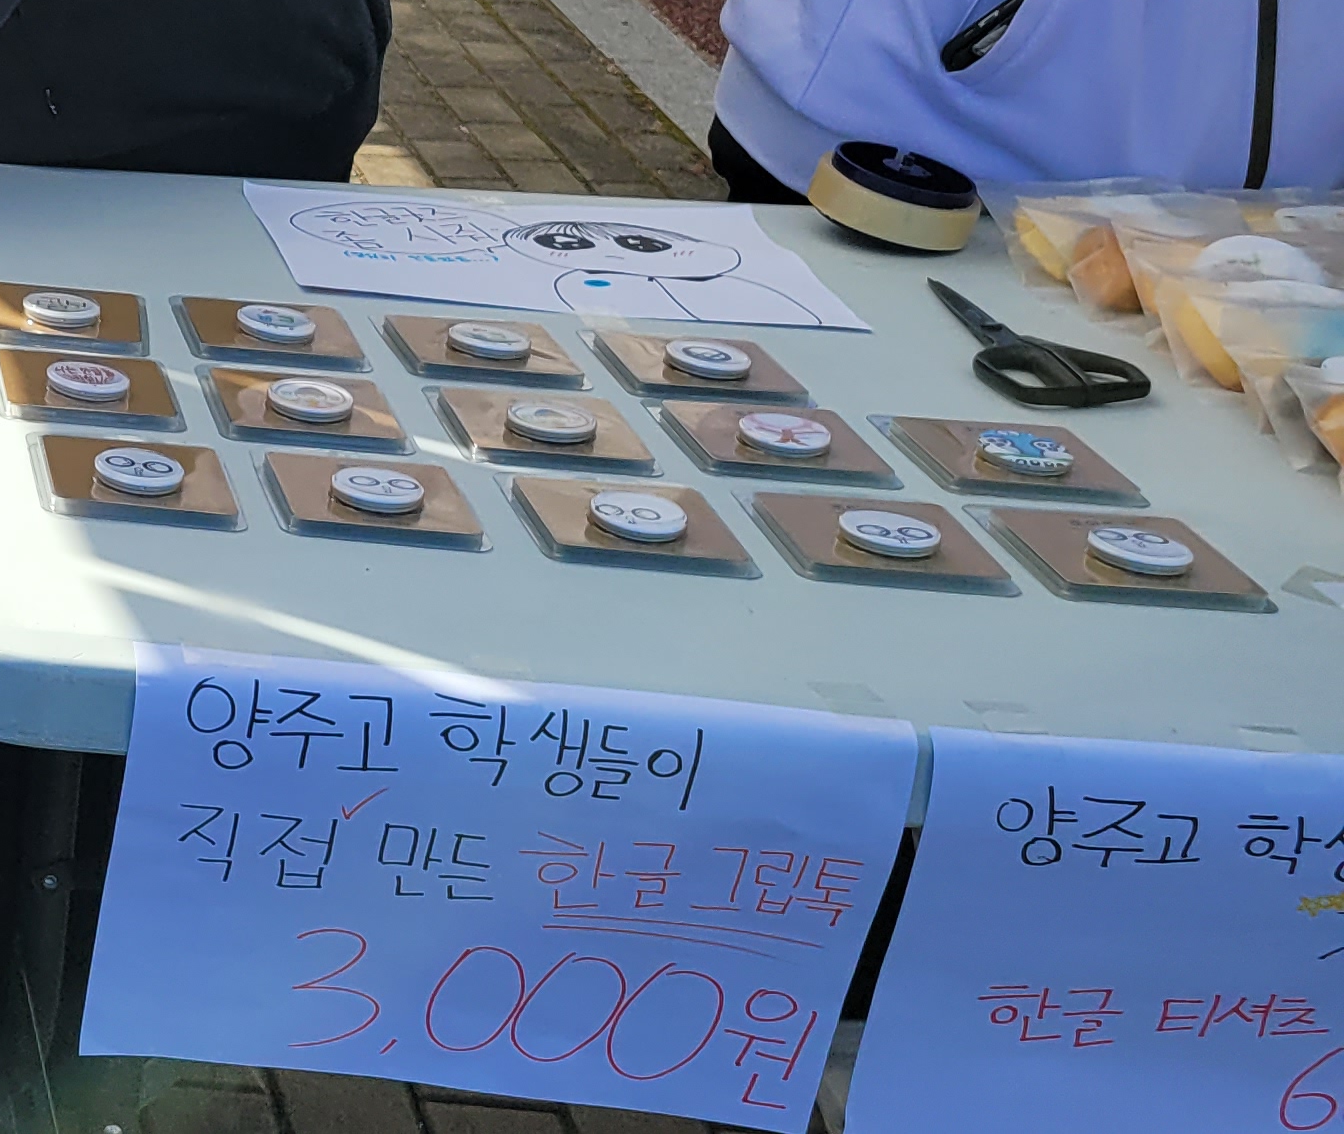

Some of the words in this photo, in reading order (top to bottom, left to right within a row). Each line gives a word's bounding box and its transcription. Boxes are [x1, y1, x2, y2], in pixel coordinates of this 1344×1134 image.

[185, 676, 400, 772] 양주고
[428, 692, 705, 811] 학생들이
[178, 803, 340, 891] 직접
[377, 822, 495, 902] 만든
[996, 785, 1202, 869] 양주고
[286, 926, 820, 1112] 3,000원
[977, 984, 1125, 1049] 한글
[1155, 993, 1331, 1039] 티셔츠
